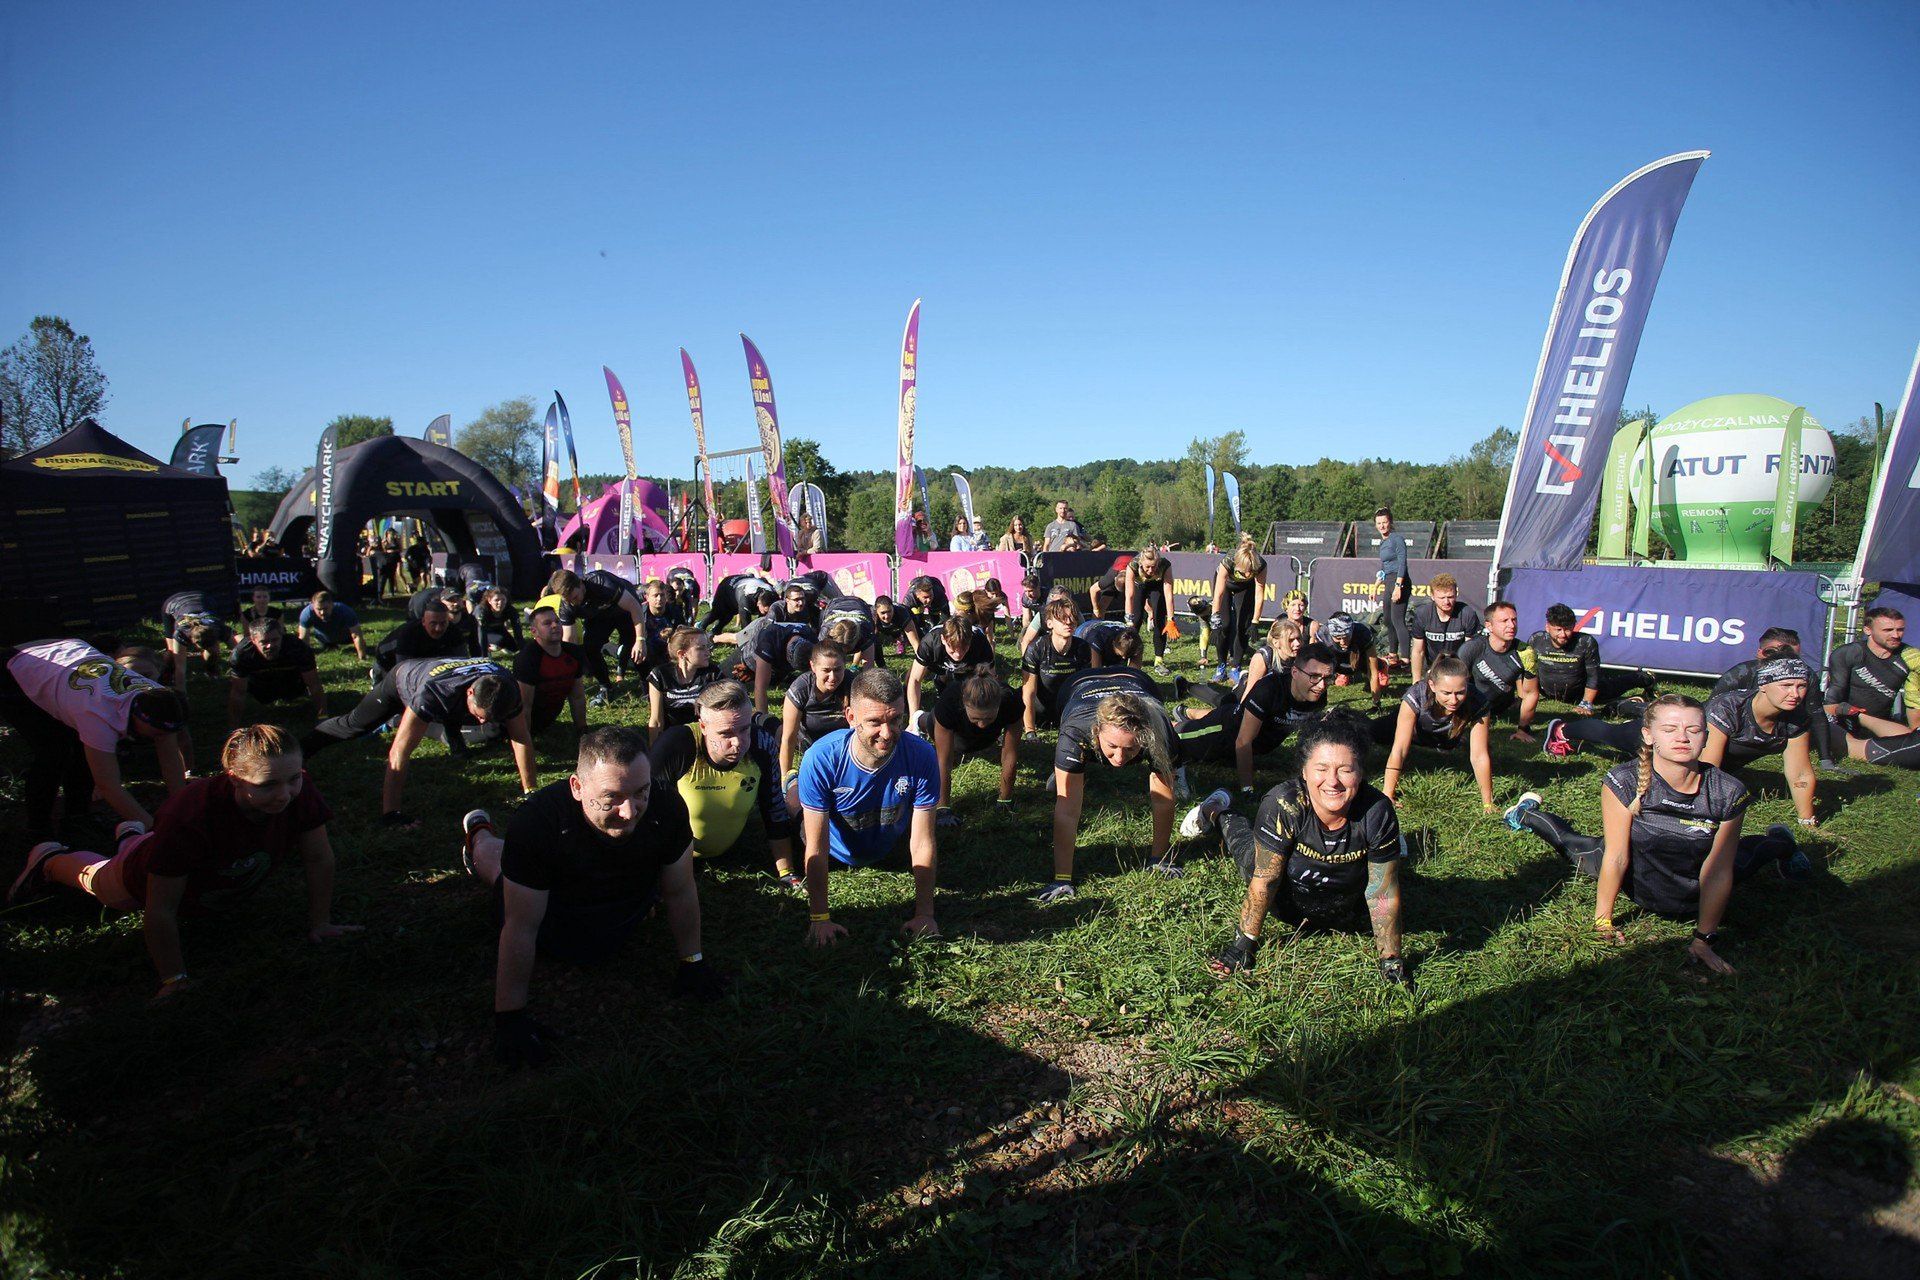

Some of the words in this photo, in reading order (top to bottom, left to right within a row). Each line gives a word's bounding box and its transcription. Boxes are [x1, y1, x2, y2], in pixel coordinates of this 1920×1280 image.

[1555, 268, 1632, 426] HELIOS
[45, 457, 150, 470] RUNMAGEDDON
[1616, 452, 1627, 490] RENTAL
[1667, 454, 1747, 477] ATUT
[1789, 442, 1798, 485] RENTAL
[317, 442, 333, 555] WATCHMARK
[386, 481, 460, 496] START
[749, 480, 761, 518] HELIOS
[1615, 493, 1626, 520] ATUT
[1681, 508, 1731, 517] REMONT
[1786, 490, 1796, 519] ATUT
[238, 573, 299, 585] HMARK
[1610, 611, 1745, 647] HELIOS
